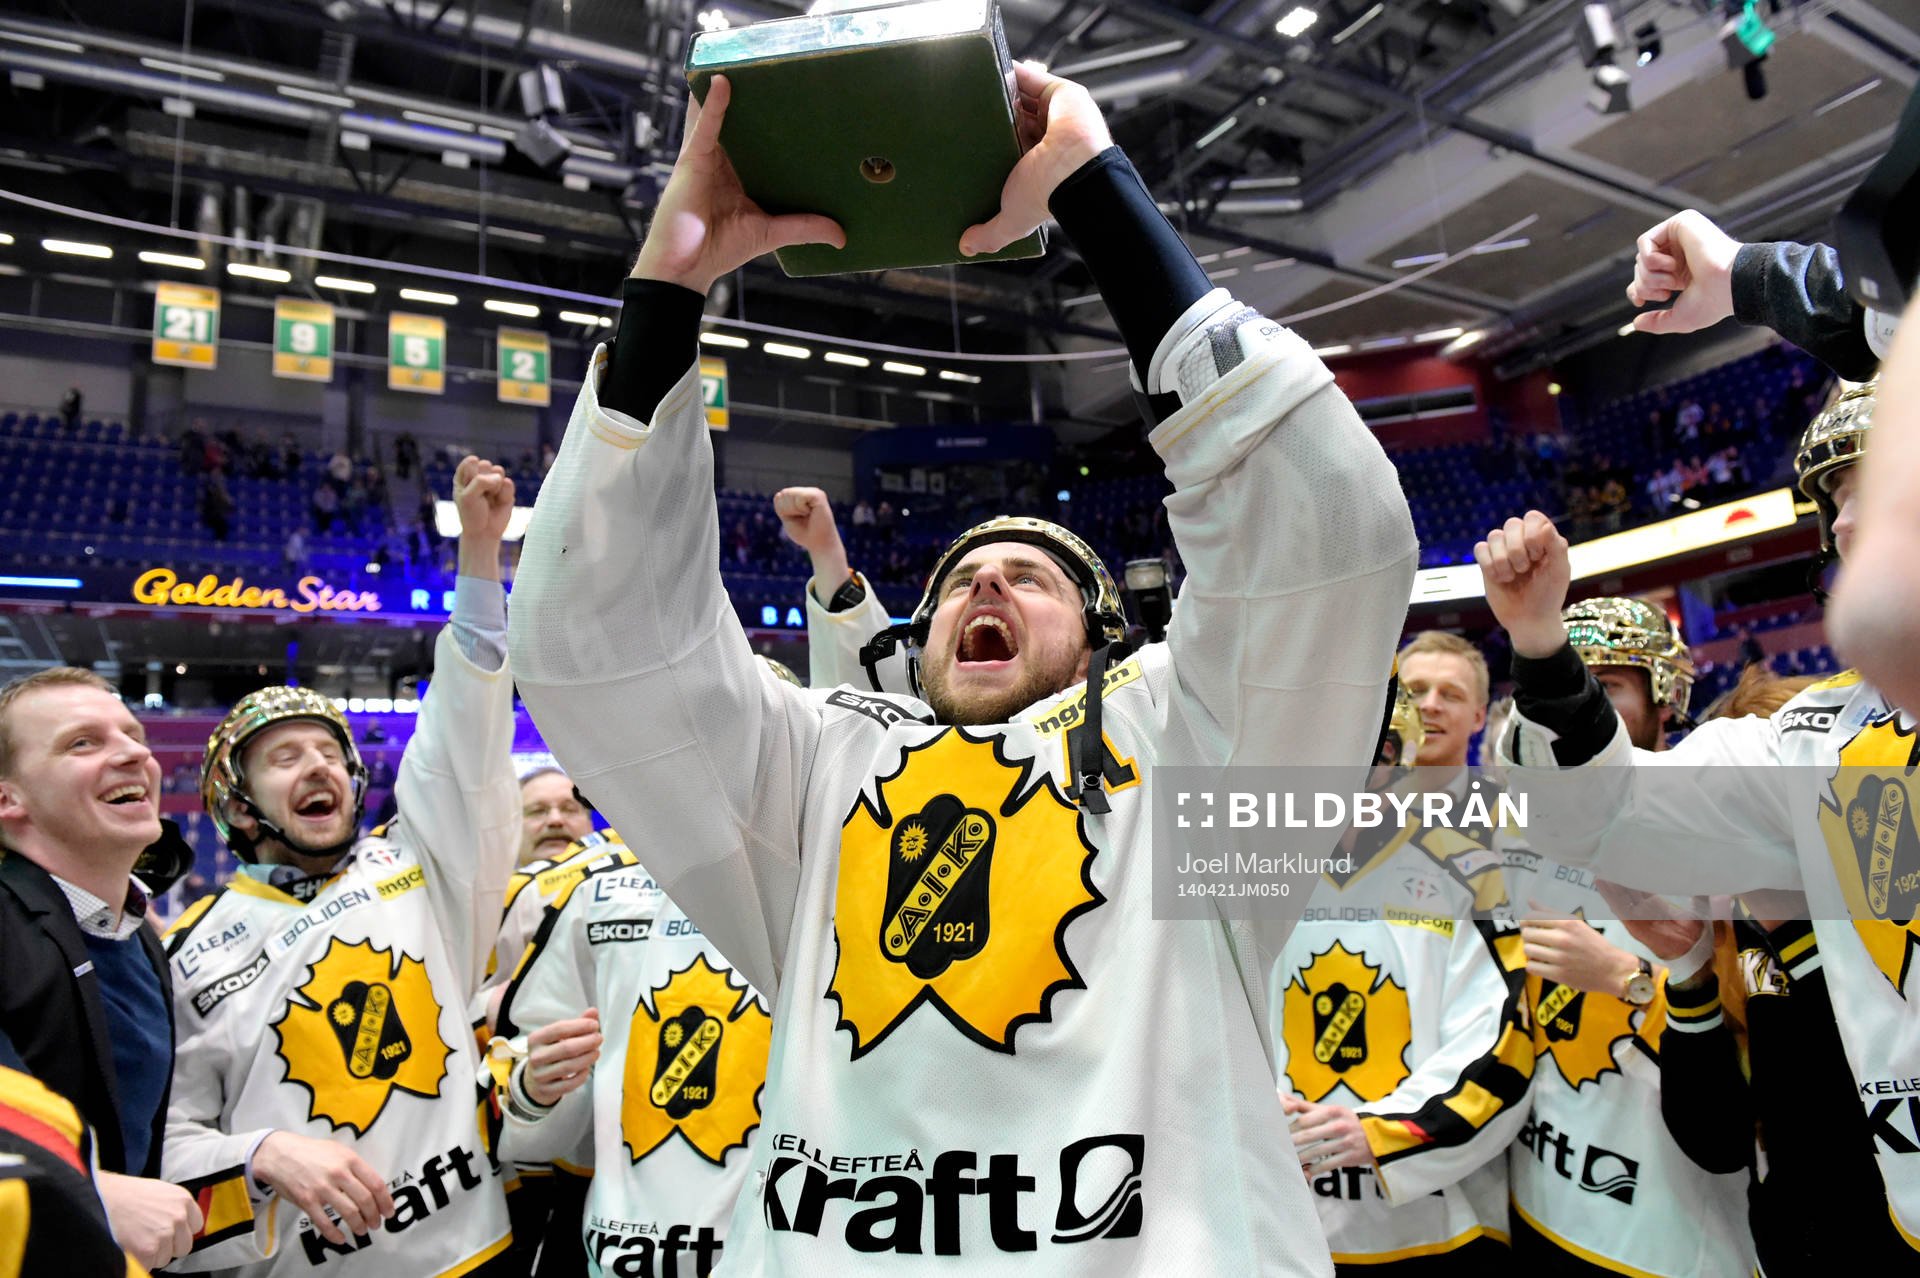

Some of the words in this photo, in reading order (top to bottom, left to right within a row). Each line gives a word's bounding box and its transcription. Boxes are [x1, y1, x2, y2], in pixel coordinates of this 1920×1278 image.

[164, 306, 209, 342] 21
[290, 322, 318, 353] 9
[403, 335, 430, 367] 5
[511, 350, 537, 381] 2
[133, 567, 289, 608] Golden
[290, 576, 383, 613] Star
[1781, 710, 1839, 730] ŠKO
[282, 888, 371, 948] BOLIDEN
[933, 921, 975, 943] 1921
[1303, 906, 1379, 922] BOLIDEN
[1386, 909, 1453, 933] engcon
[200, 921, 248, 952] LEAB
[196, 956, 271, 1014] ŠKODA
[682, 1086, 708, 1100] 1921
[773, 1133, 924, 1174] ELLEFTEÅ
